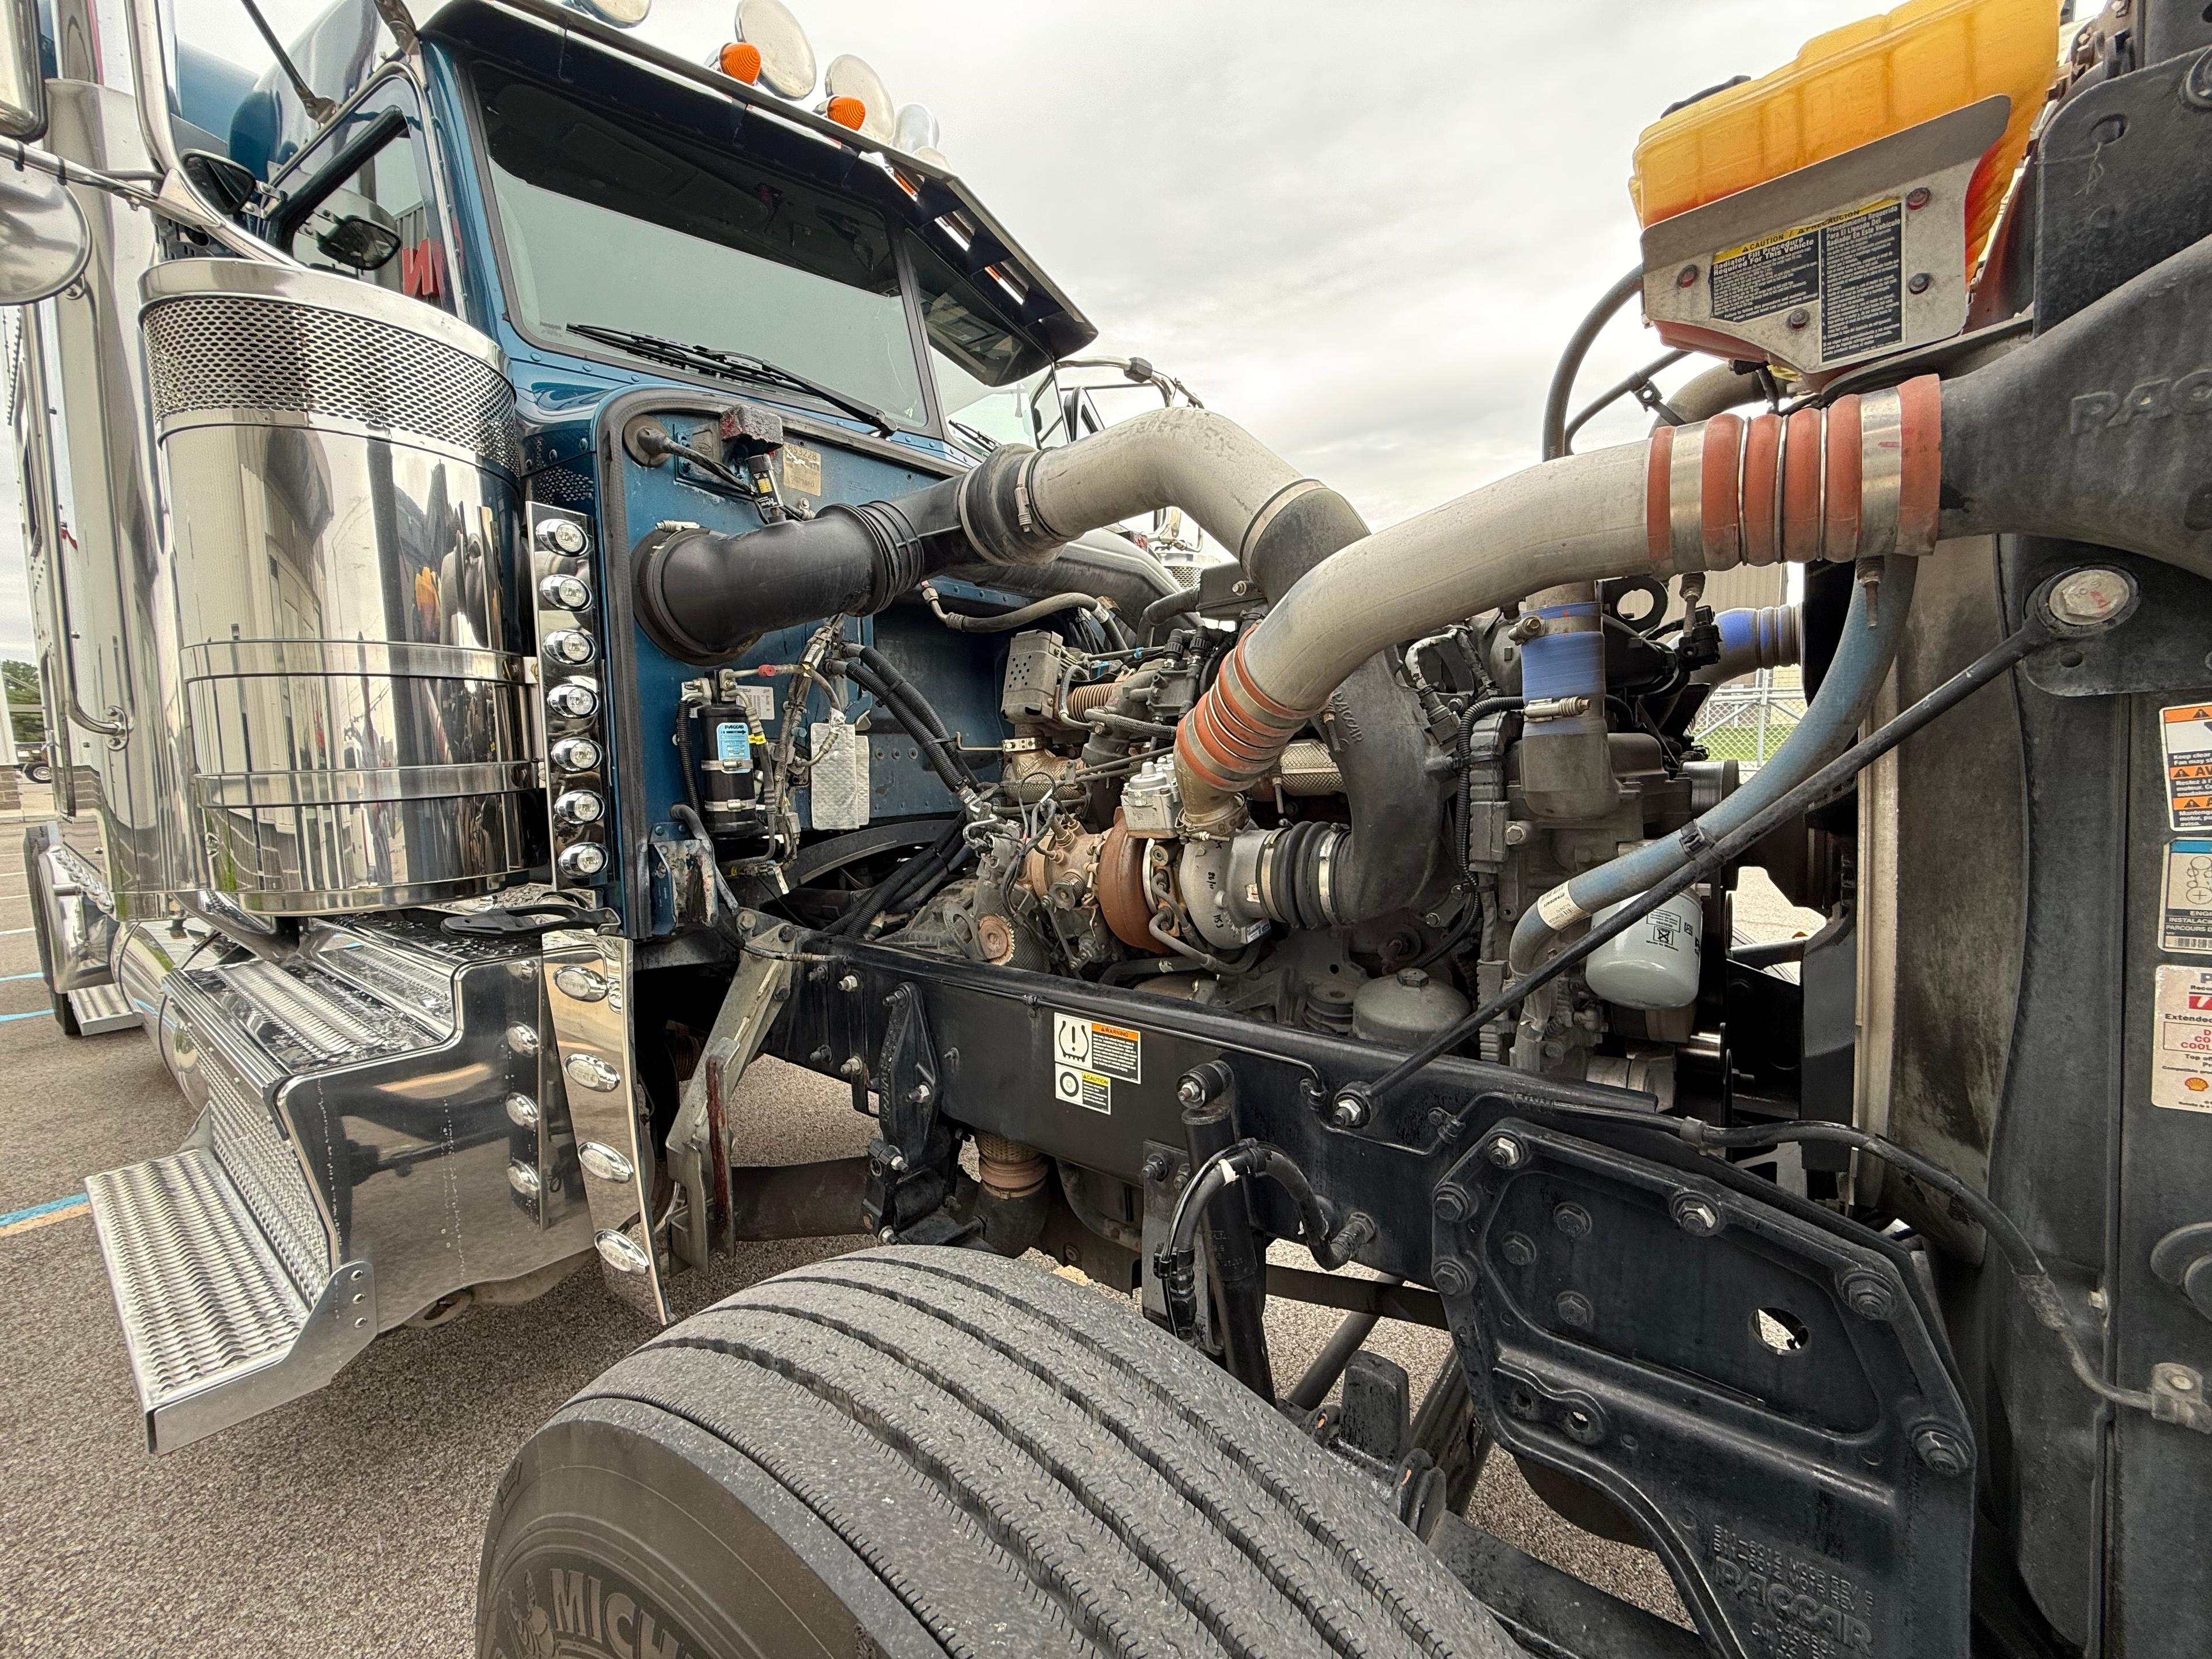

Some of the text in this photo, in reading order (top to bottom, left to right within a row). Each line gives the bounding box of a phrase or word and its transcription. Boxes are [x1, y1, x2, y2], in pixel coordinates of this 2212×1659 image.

[1714, 237, 1804, 271] Radiator Fill Procedure
[1714, 239, 1814, 276] Required For This Vehicle
[1749, 234, 1784, 250] CAUTION
[1332, 691, 1364, 743] PACCAR
[1105, 1027, 1128, 1037] WARNING
[1087, 1075, 1108, 1085] CAUTION
[1715, 1555, 1872, 1657] PACCAR
